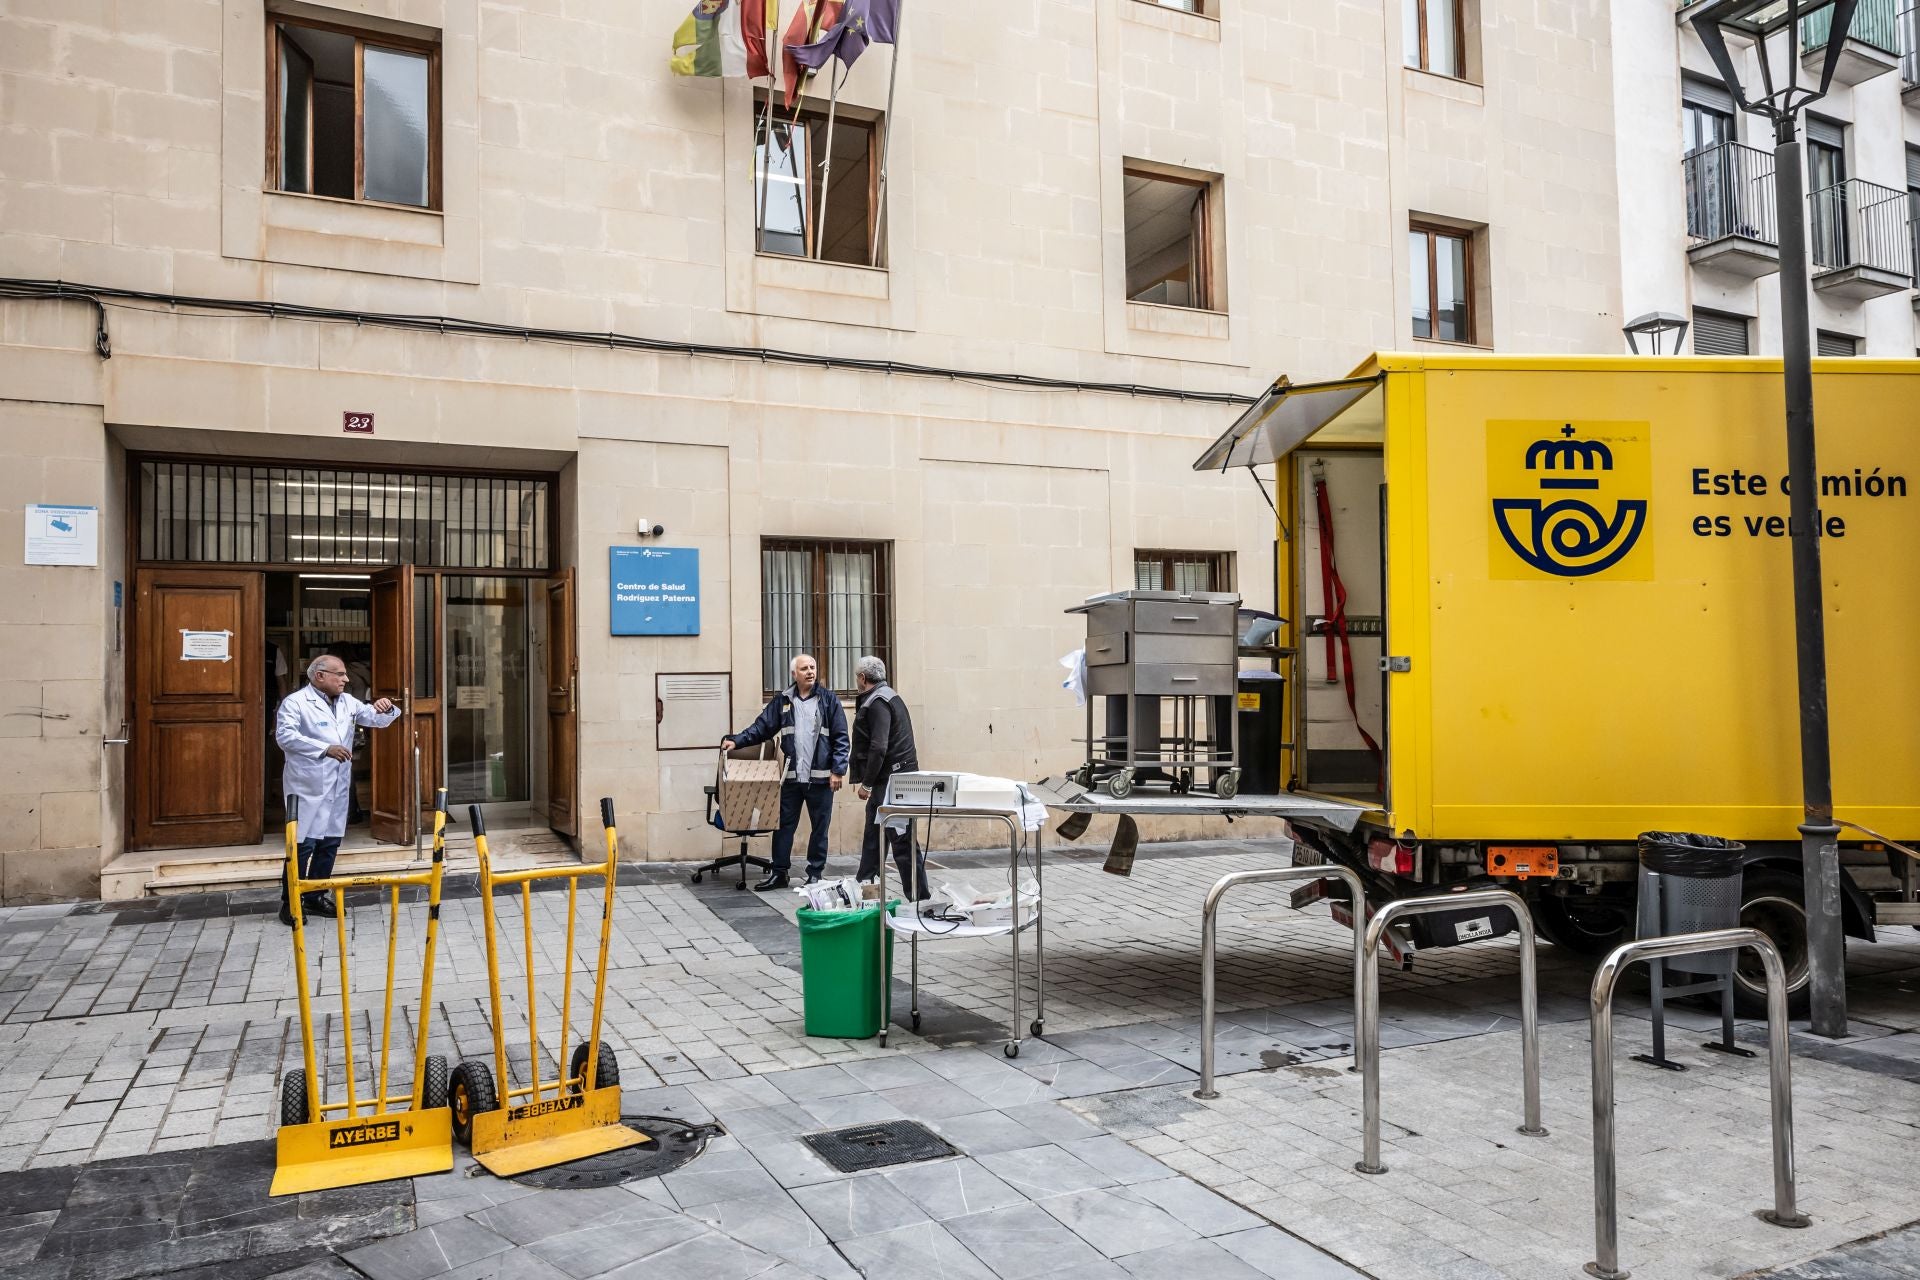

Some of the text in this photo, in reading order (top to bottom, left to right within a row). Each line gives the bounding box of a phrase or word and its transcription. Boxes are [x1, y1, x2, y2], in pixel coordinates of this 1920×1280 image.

[348, 416, 370, 429] 23
[1692, 467, 1907, 497] Este cmión
[1692, 510, 1846, 537] es vee
[616, 582, 686, 591] Centro de Salud
[616, 594, 696, 603] Rodríguez Paterna
[522, 1098, 571, 1118] AYERBE
[334, 1125, 397, 1145] AYERBE
